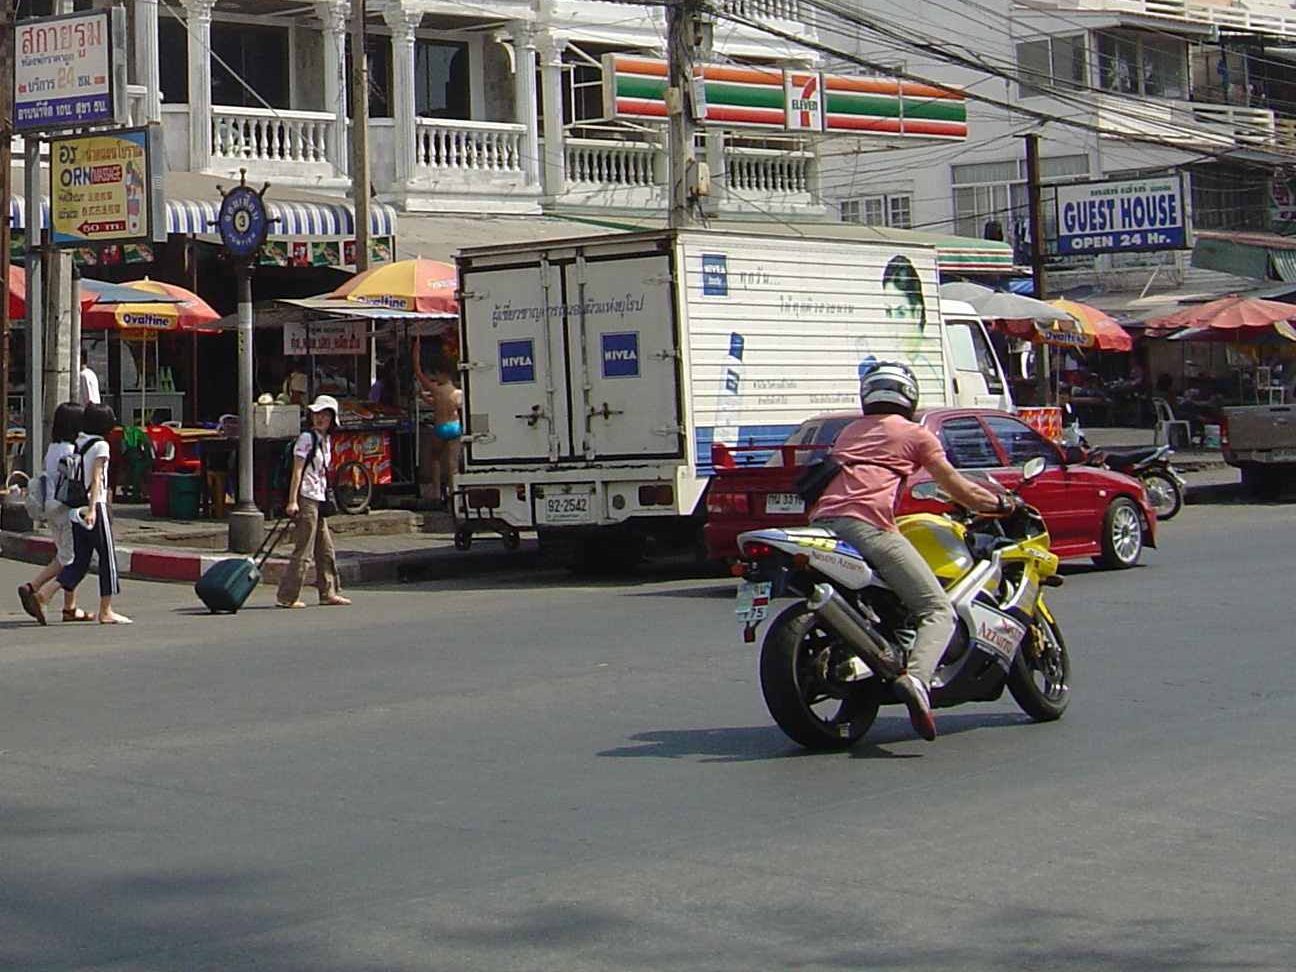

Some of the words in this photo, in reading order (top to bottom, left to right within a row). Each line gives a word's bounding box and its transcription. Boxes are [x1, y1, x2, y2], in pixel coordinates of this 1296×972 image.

[27, 77, 55, 93] บริการ
[57, 66, 75, 89] 24
[1064, 198, 1116, 234] GUEST
[1120, 194, 1178, 229] HOUSE
[83, 223, 100, 233] 50
[238, 215, 247, 228] 3
[1071, 235, 1114, 250] OPEN
[1119, 234, 1142, 247] 24
[1147, 232, 1172, 245] Hr.
[123, 313, 170, 327] Ovaltine
[501, 356, 533, 368] NIVEA
[605, 349, 637, 361] NIVEA
[547, 498, 587, 512] 92-2542
[811, 550, 837, 565] Nastro
[978, 622, 1014, 654] Azzurro
